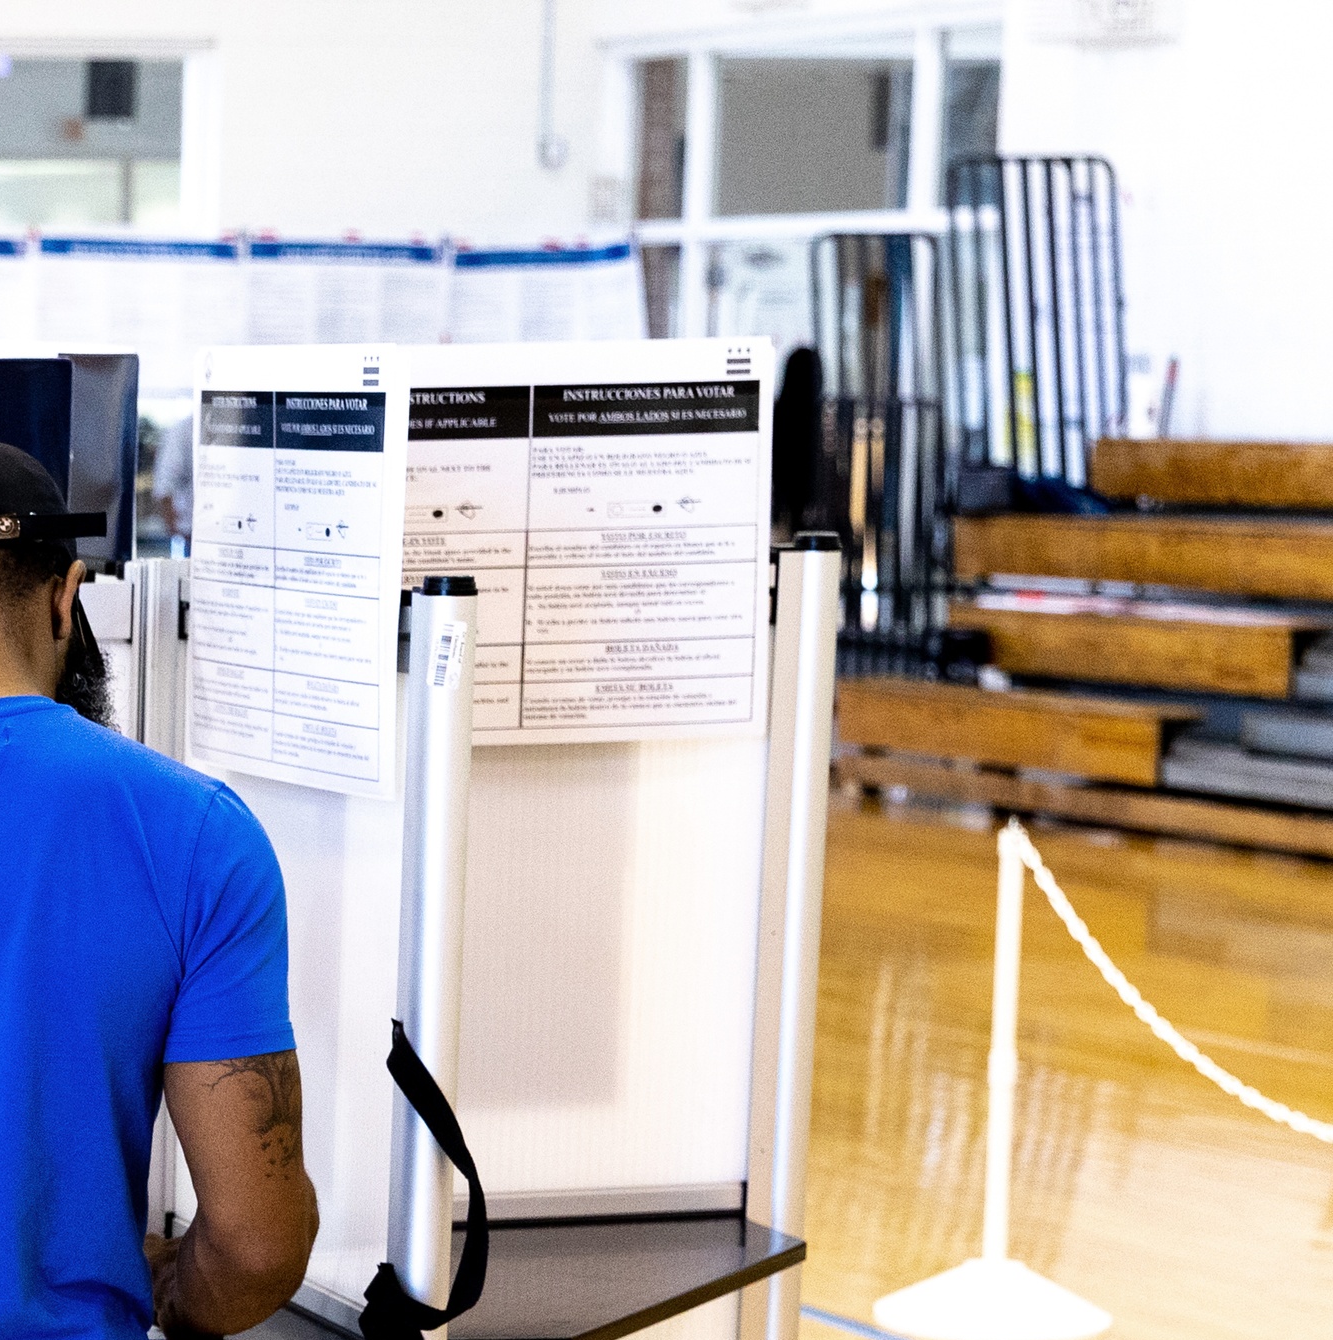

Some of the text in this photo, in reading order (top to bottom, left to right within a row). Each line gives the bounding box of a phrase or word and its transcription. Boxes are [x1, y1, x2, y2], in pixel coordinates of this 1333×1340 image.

[562, 384, 735, 402] INSTRUCCIONES PARA VOTAR
